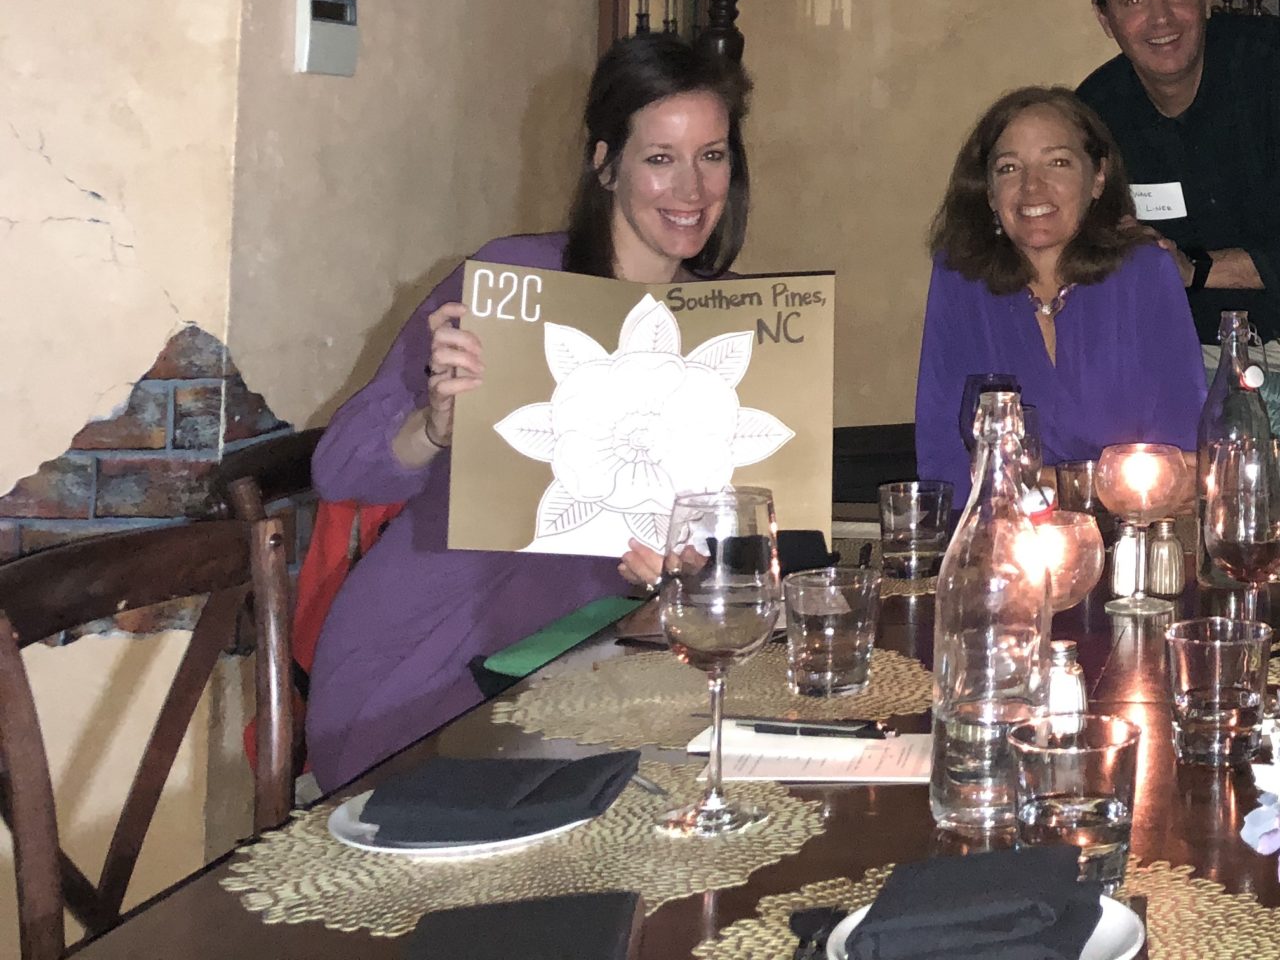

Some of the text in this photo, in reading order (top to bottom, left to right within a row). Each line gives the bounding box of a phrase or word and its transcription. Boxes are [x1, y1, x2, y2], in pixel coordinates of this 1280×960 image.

[472, 269, 542, 322] C2C
[666, 282, 826, 312] Southern Pines,
[757, 311, 804, 344] NC
